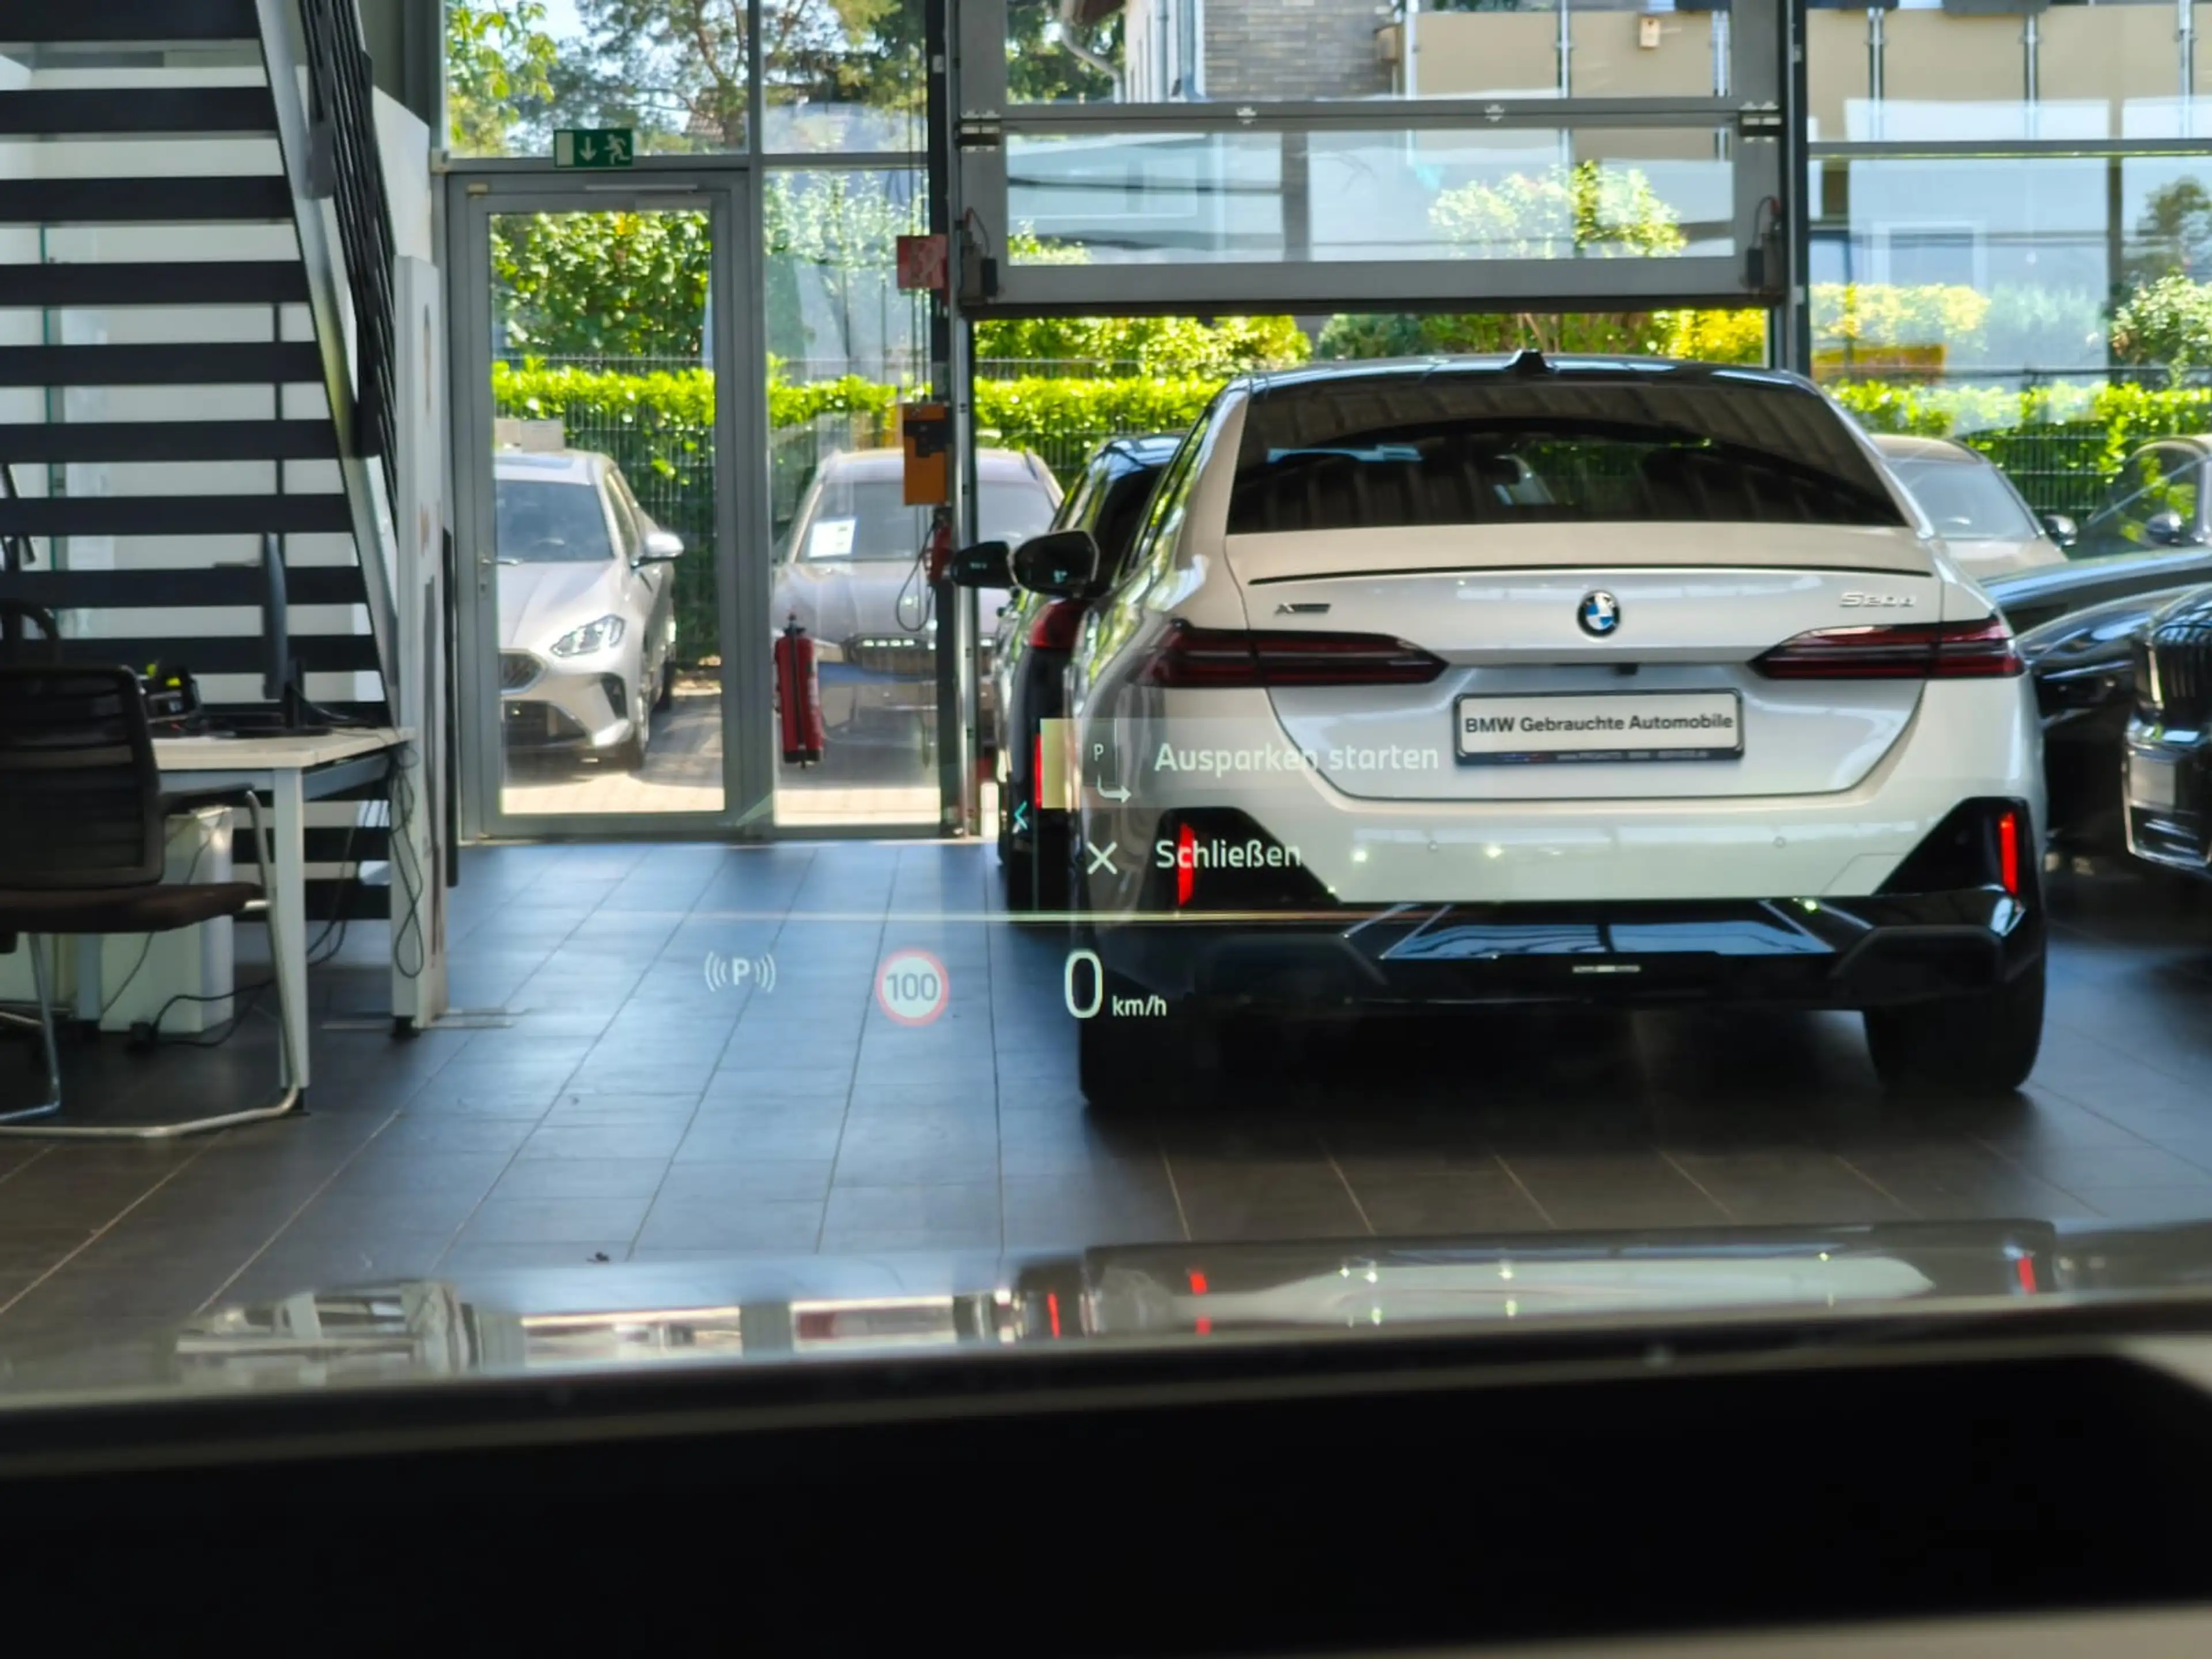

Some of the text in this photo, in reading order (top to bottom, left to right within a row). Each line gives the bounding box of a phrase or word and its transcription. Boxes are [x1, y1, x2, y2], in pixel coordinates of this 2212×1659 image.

[1465, 712, 1733, 733] BMW Gebrauchte Automobile
[1094, 743, 1104, 762] P
[1154, 743, 1440, 778] Ausparken starten
[1156, 839, 1301, 868] Schließen
[732, 958, 750, 986] P
[1065, 949, 1167, 1018] 0 km/h
[886, 973, 938, 1001] 100
